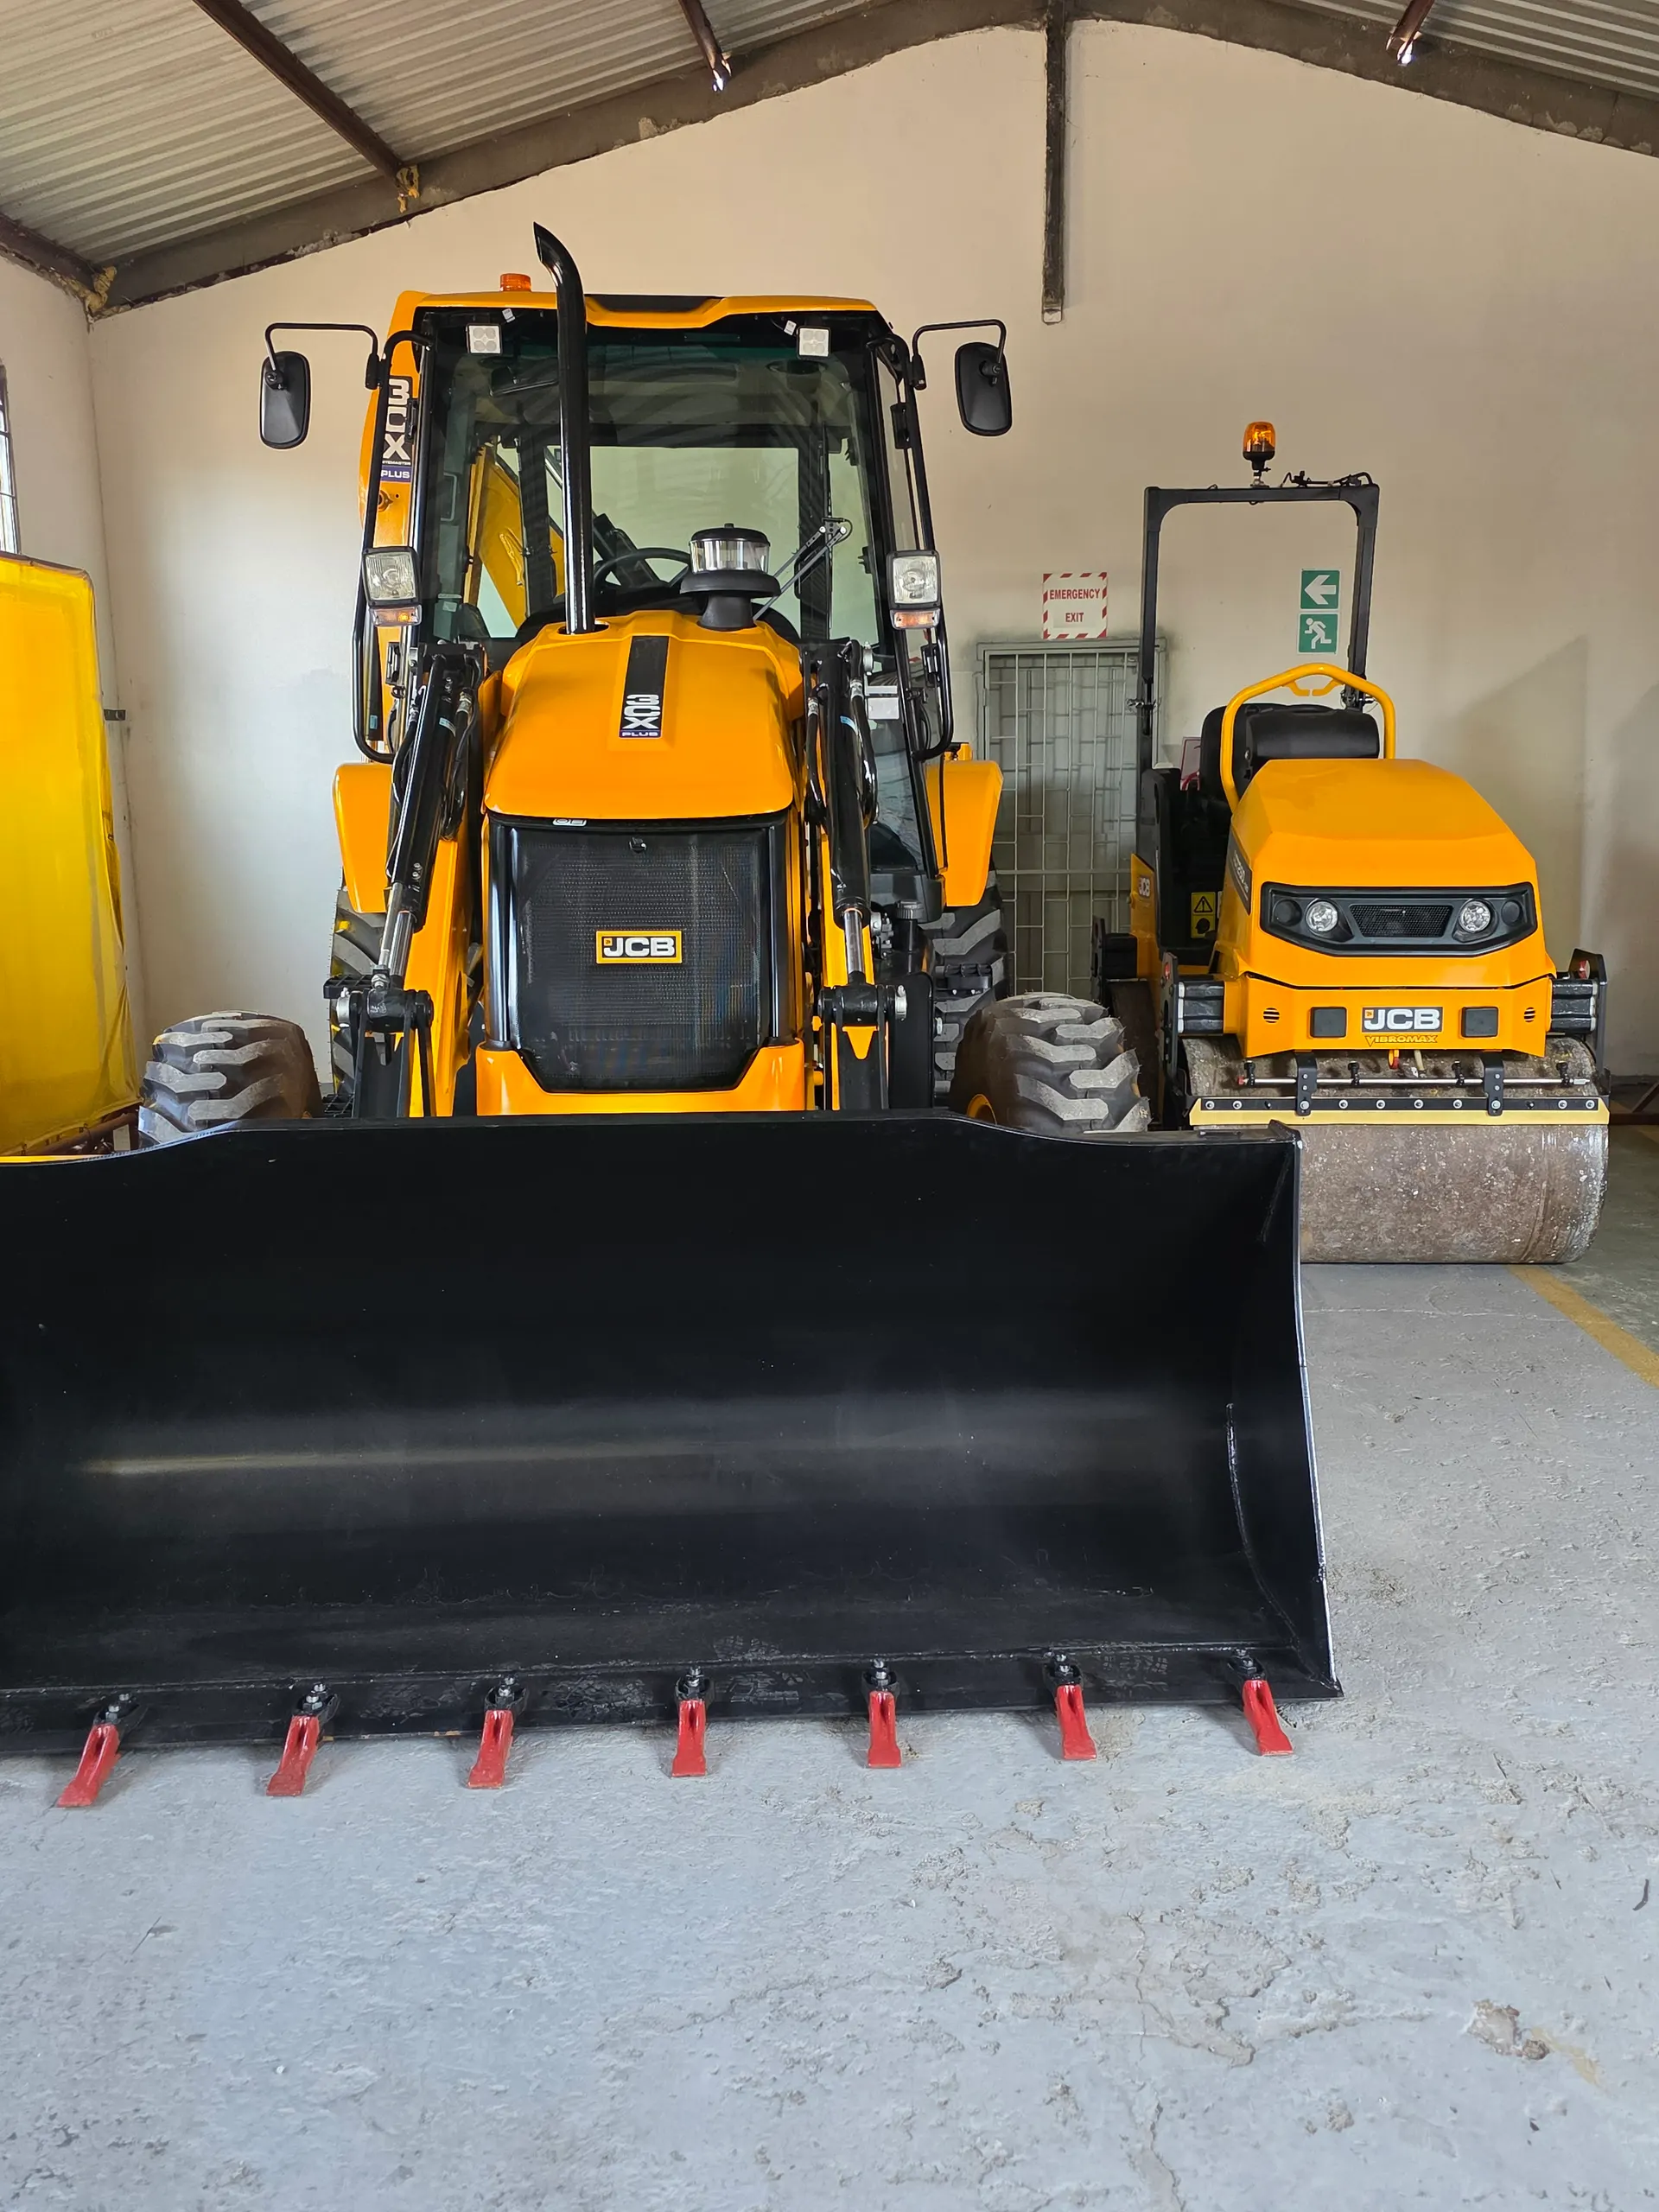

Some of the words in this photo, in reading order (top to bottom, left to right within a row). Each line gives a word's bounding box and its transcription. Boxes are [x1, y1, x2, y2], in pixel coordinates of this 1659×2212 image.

[383, 378, 410, 461] 3CX
[380, 469, 410, 479] PLUS
[1049, 588, 1101, 600] EMERGENCY
[1065, 612, 1084, 623] EXIT
[622, 694, 661, 729] 3CX
[603, 937, 675, 957] JCB
[1363, 1008, 1440, 1030] JCB
[1364, 1035, 1438, 1047] VIBROMAX
